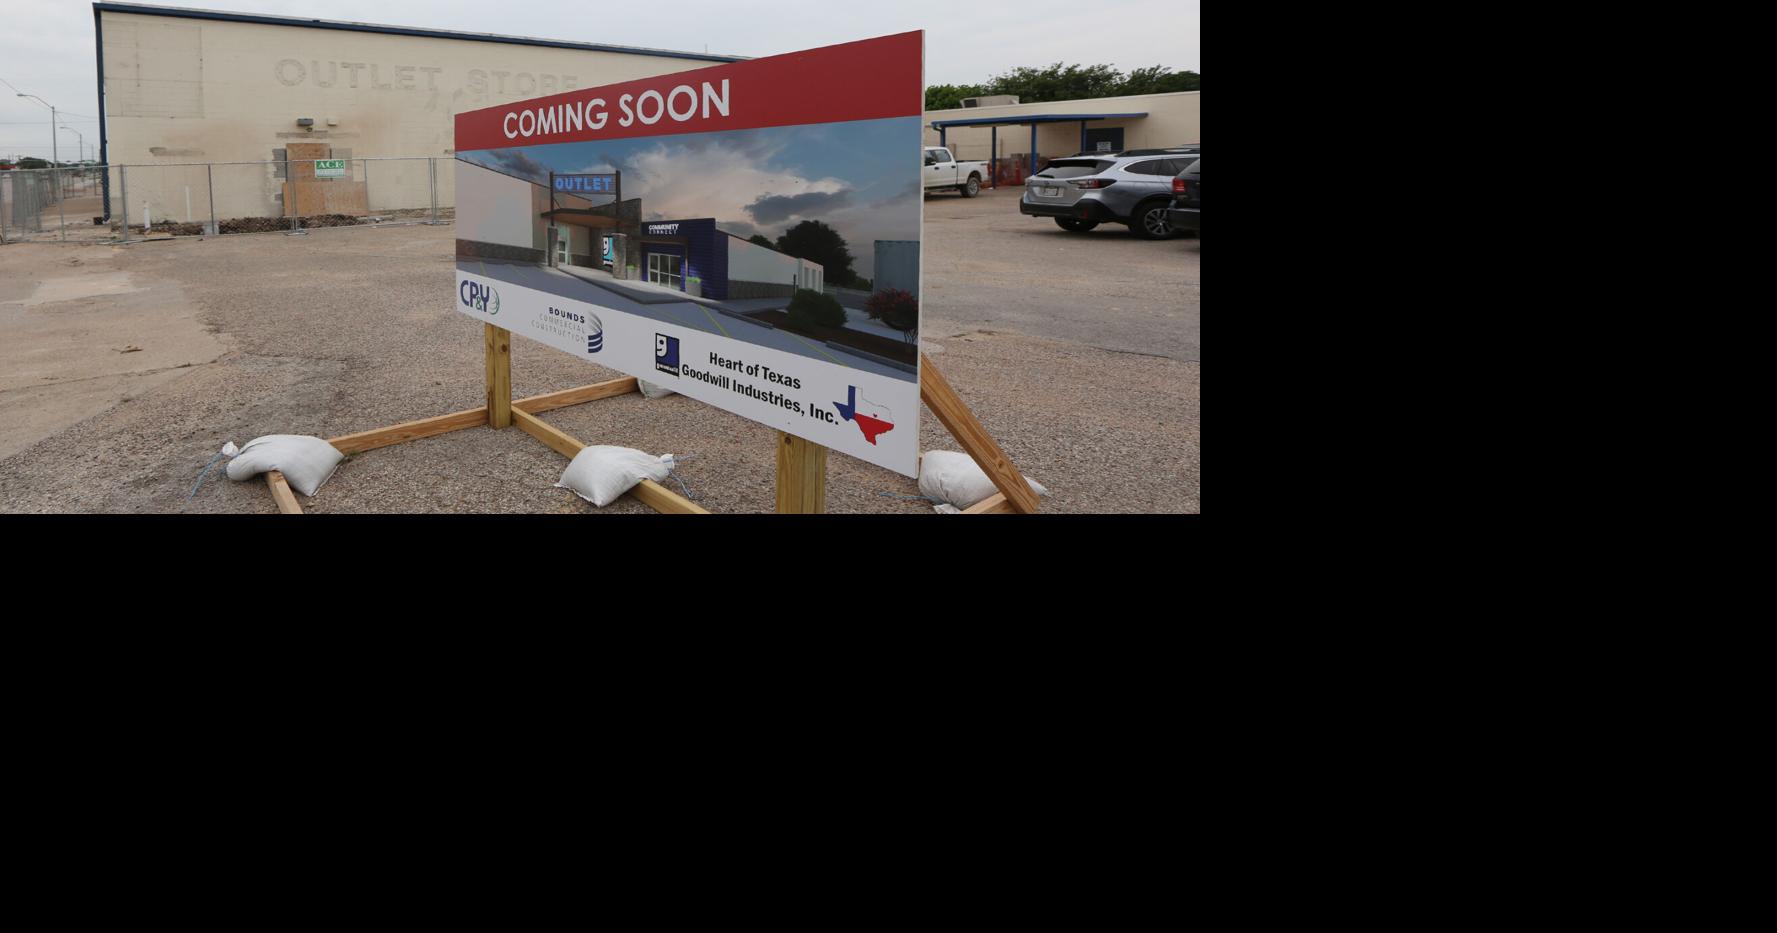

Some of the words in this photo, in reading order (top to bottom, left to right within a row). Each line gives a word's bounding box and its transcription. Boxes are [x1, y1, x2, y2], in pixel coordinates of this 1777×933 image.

[274, 59, 442, 91] OUTLET
[503, 98, 608, 140] COMING
[619, 78, 730, 127] SOON
[555, 175, 612, 192] OUTLET
[539, 313, 586, 334] COMMERCIAL
[549, 306, 585, 324] BOUNDS
[530, 319, 586, 343] CONSTRUCTION
[709, 351, 744, 373] Heart
[746, 364, 760, 377] of
[762, 366, 801, 389] Texas
[682, 364, 729, 389] Goodwill
[733, 379, 805, 416] Industries,
[809, 403, 839, 425] Inc.
